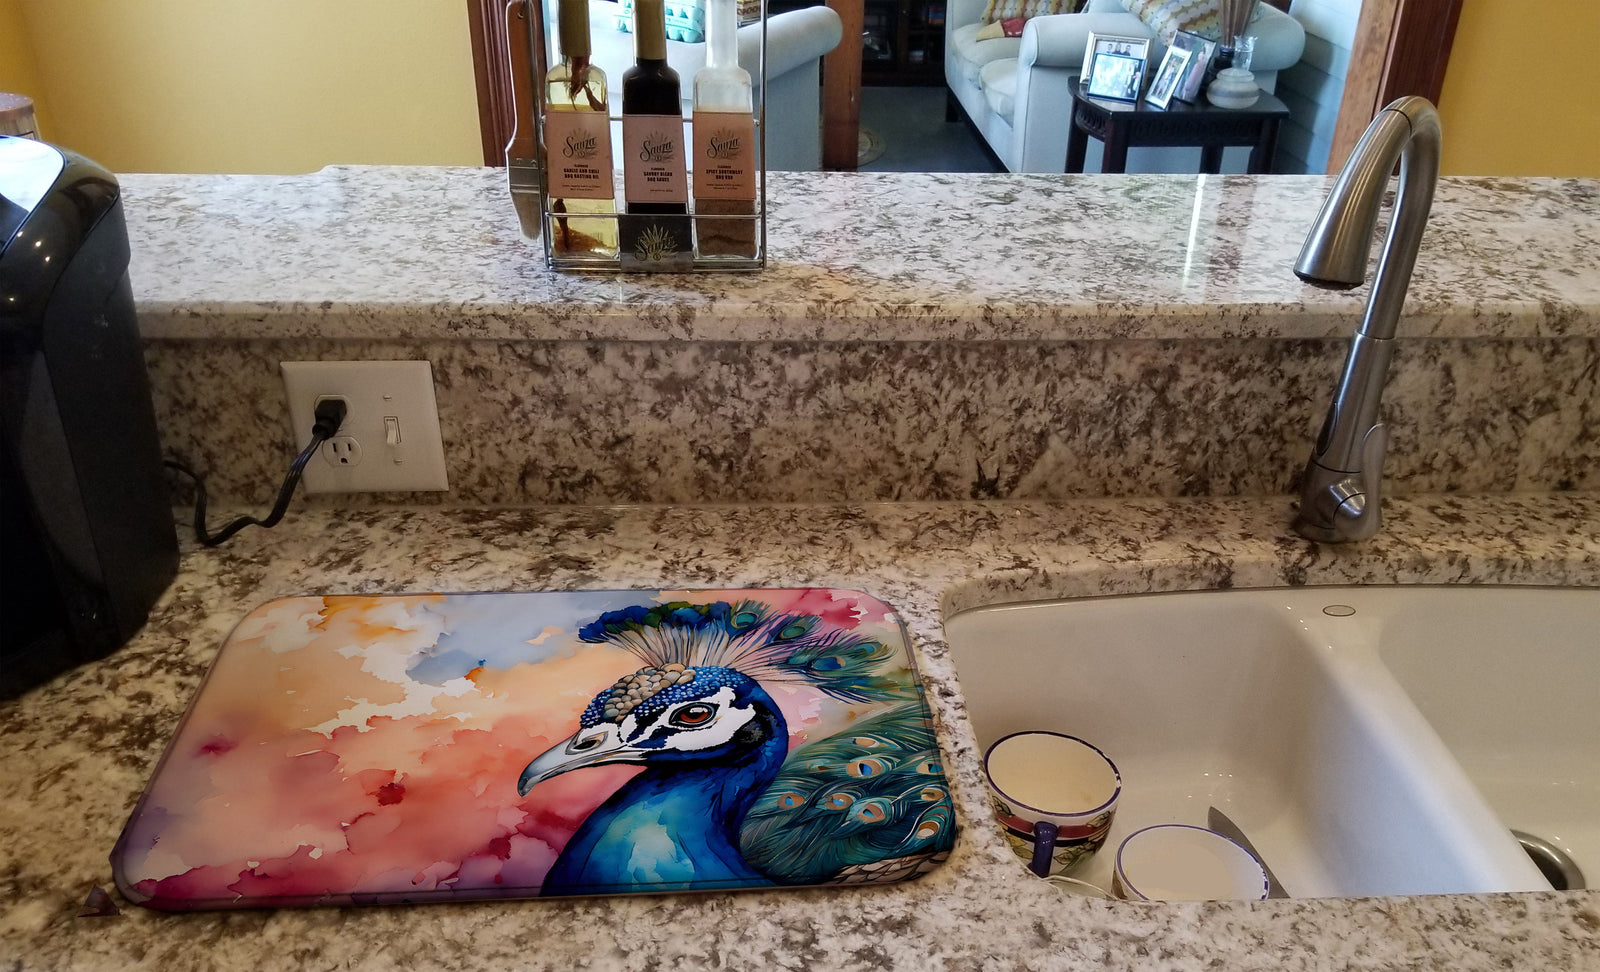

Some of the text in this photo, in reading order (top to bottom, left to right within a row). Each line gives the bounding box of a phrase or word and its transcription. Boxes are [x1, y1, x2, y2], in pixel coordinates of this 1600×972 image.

[563, 136, 597, 158] Sauza
[640, 140, 673, 161] Sauza
[707, 136, 739, 158] Sauza
